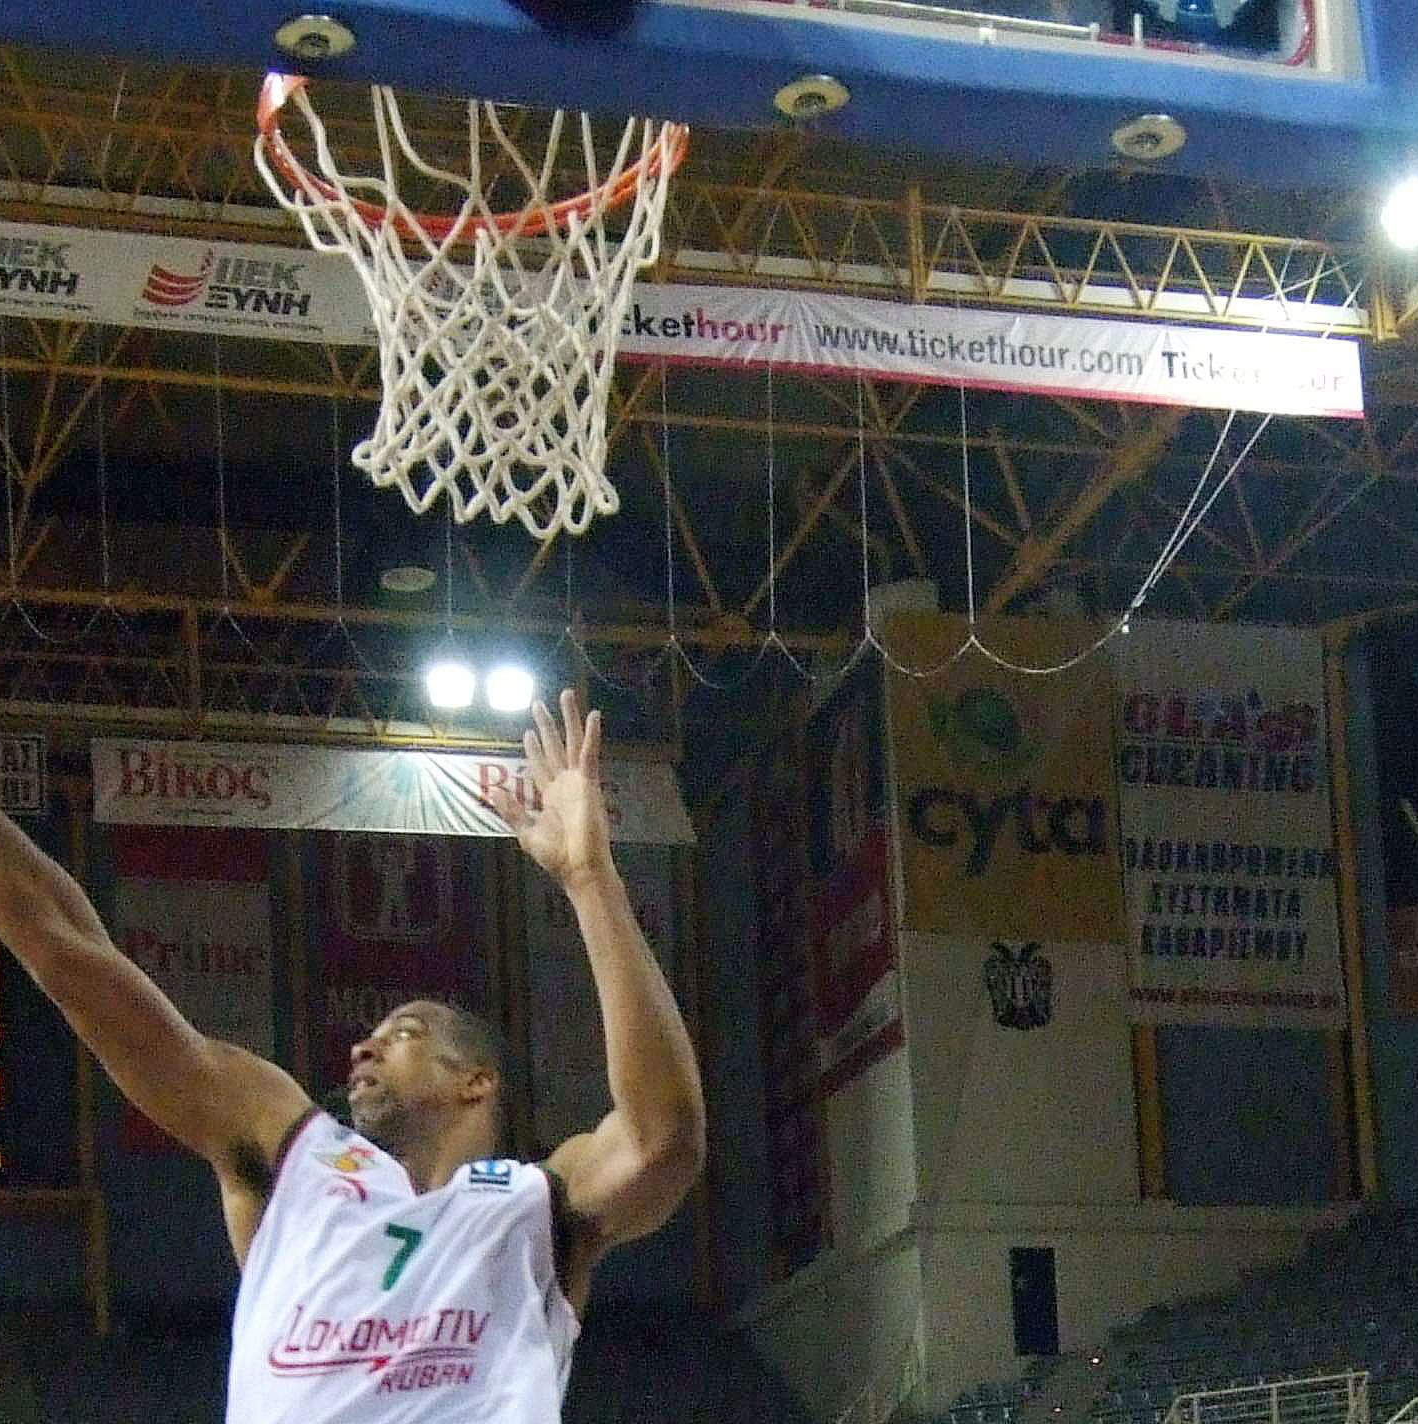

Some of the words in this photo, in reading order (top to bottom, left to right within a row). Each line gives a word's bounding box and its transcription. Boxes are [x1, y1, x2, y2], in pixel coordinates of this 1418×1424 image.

[587, 302, 787, 343] kethour
[812, 322, 1145, 377] www.tickethour.com
[907, 786, 1106, 878] cyta
[382, 1222, 423, 1292] 7
[282, 1304, 491, 1354] LOKOMOTIV
[374, 1363, 471, 1394] KUBAN
